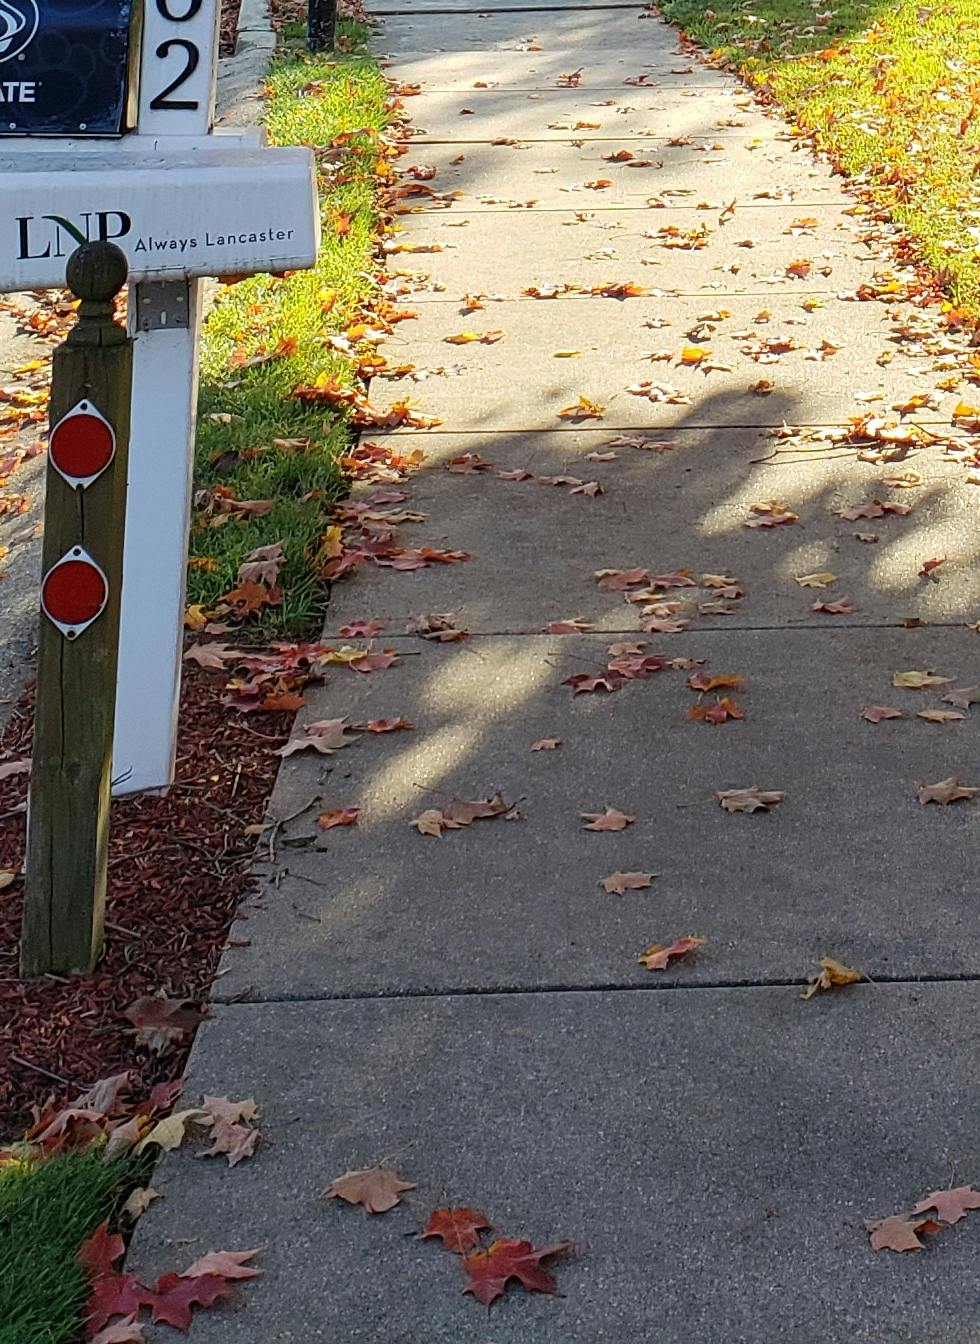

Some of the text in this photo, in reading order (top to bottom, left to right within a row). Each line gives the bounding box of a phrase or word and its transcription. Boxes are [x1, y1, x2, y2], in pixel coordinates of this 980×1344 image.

[15, 210, 294, 259] LNP Always Lancaster
